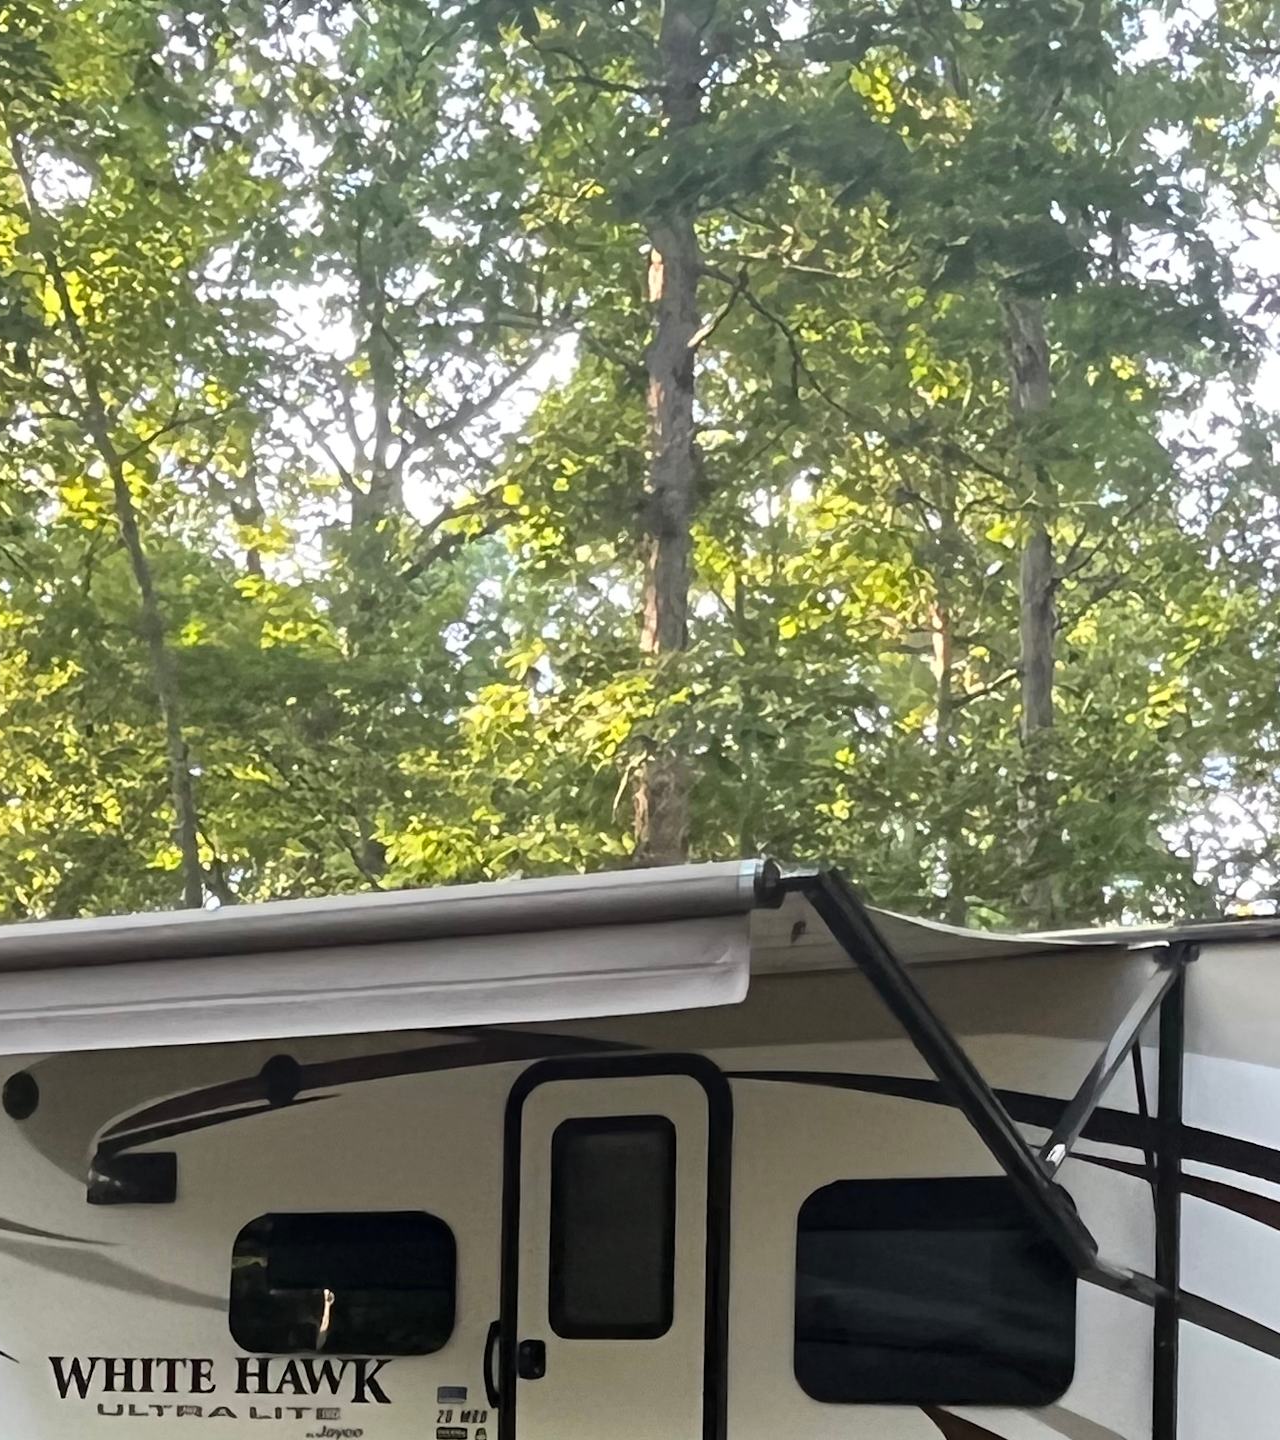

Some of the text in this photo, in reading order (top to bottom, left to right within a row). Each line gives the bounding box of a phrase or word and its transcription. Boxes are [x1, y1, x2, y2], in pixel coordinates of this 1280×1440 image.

[47, 1356, 393, 1404] WHITE HAWK
[96, 1403, 341, 1421] ULTRA LITE
